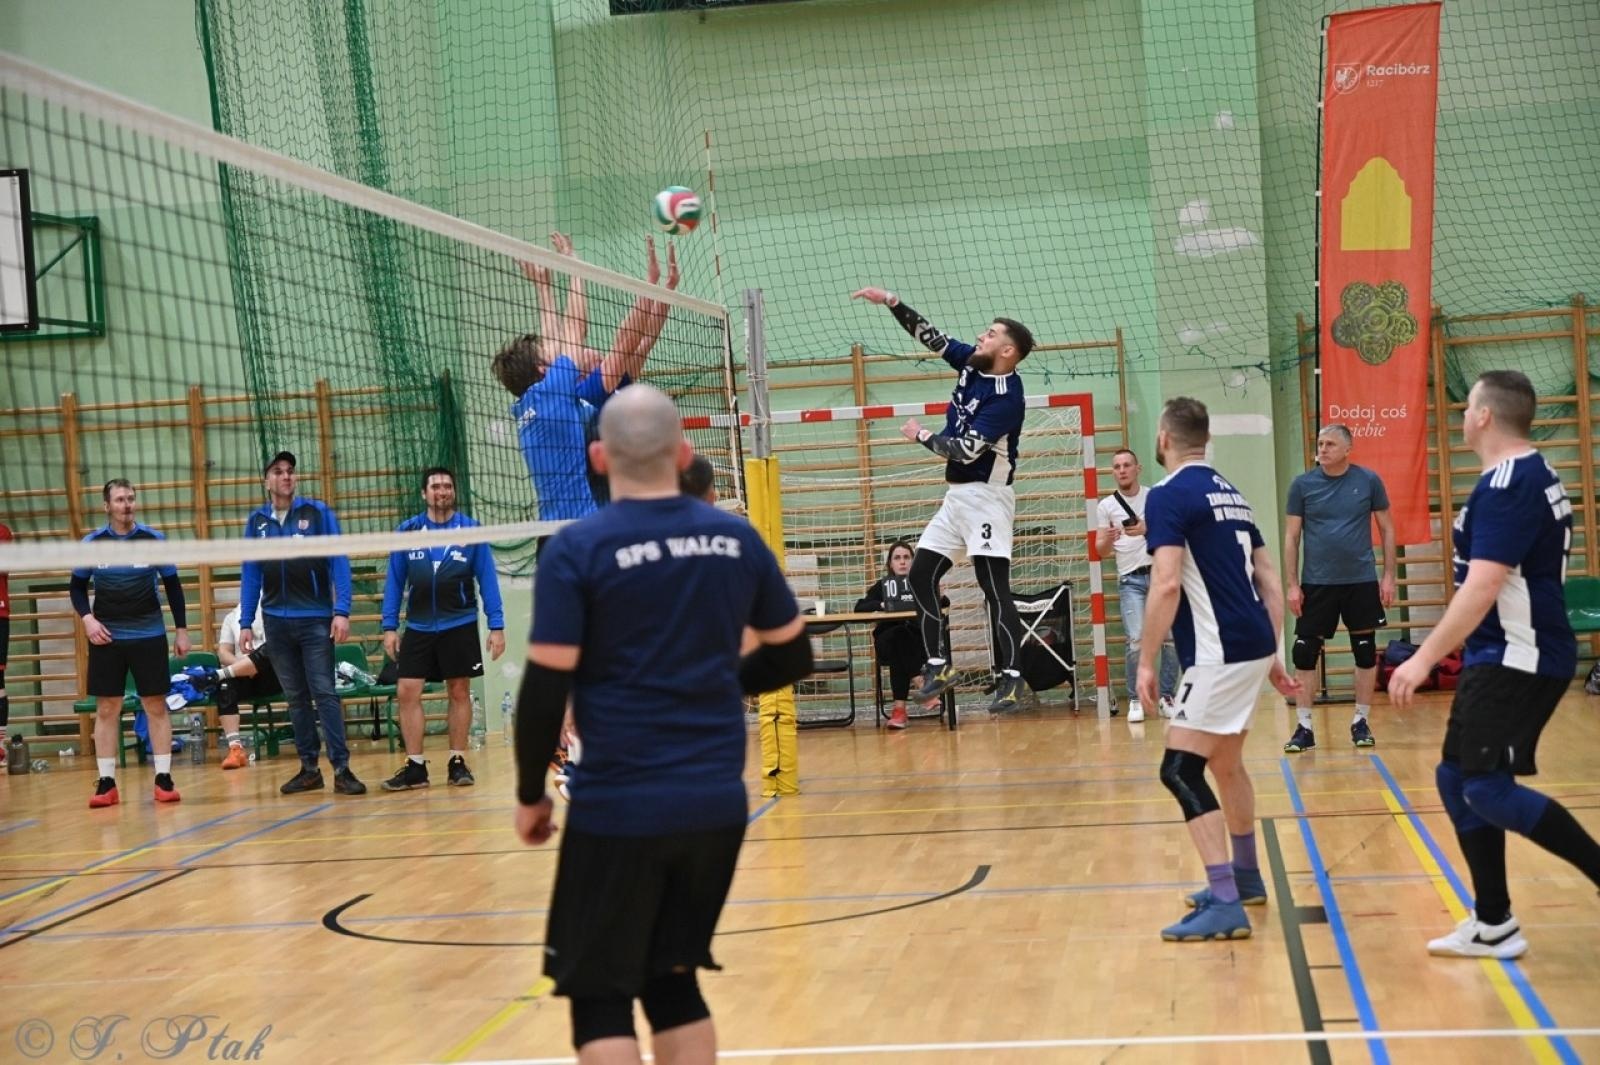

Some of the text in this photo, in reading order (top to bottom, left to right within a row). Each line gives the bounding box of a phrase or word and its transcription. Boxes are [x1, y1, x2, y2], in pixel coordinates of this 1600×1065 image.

[1366, 63, 1431, 76] Racibórz
[1329, 404, 1407, 422] Dodaj coś
[981, 523, 992, 539] 3
[615, 534, 741, 569] SPS WALCE
[884, 579, 897, 598] 10
[1180, 682, 1193, 704] 7
